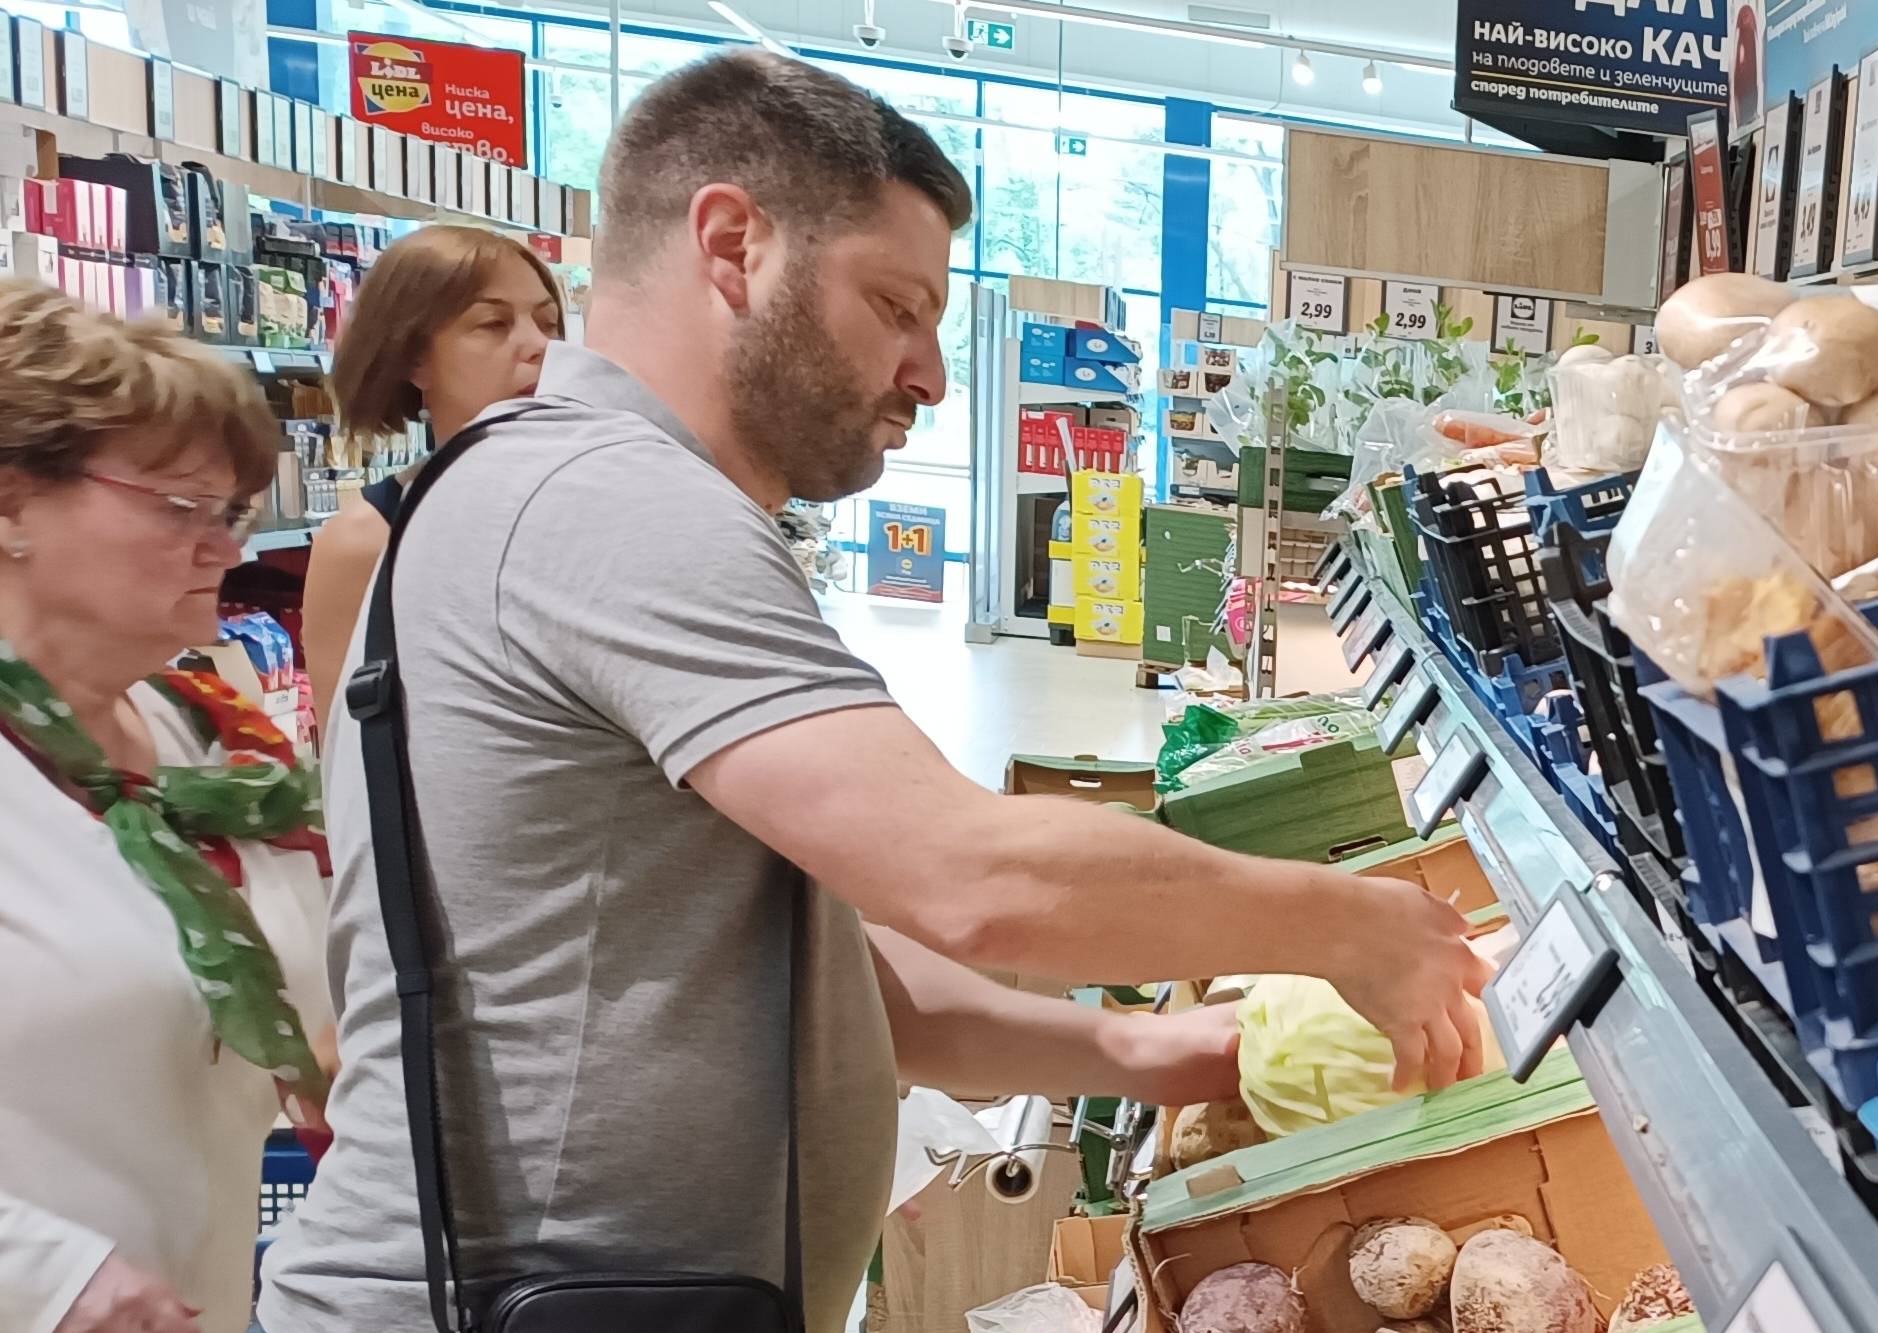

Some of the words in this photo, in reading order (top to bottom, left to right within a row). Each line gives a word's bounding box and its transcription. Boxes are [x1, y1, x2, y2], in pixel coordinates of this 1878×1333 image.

[1472, 51, 1493, 66] на
[1497, 54, 1596, 80] плодовете
[1600, 69, 1611, 82] и
[1614, 70, 1728, 97] зеленчуците
[371, 83, 420, 101] цена
[445, 83, 490, 99] Ниска
[1471, 80, 1526, 100] според
[1529, 87, 1659, 114] потребителите
[445, 100, 514, 124] цена,
[1300, 302, 1332, 319] 2,99
[1395, 312, 1426, 330] 2,99
[884, 522, 932, 557] 1+1
